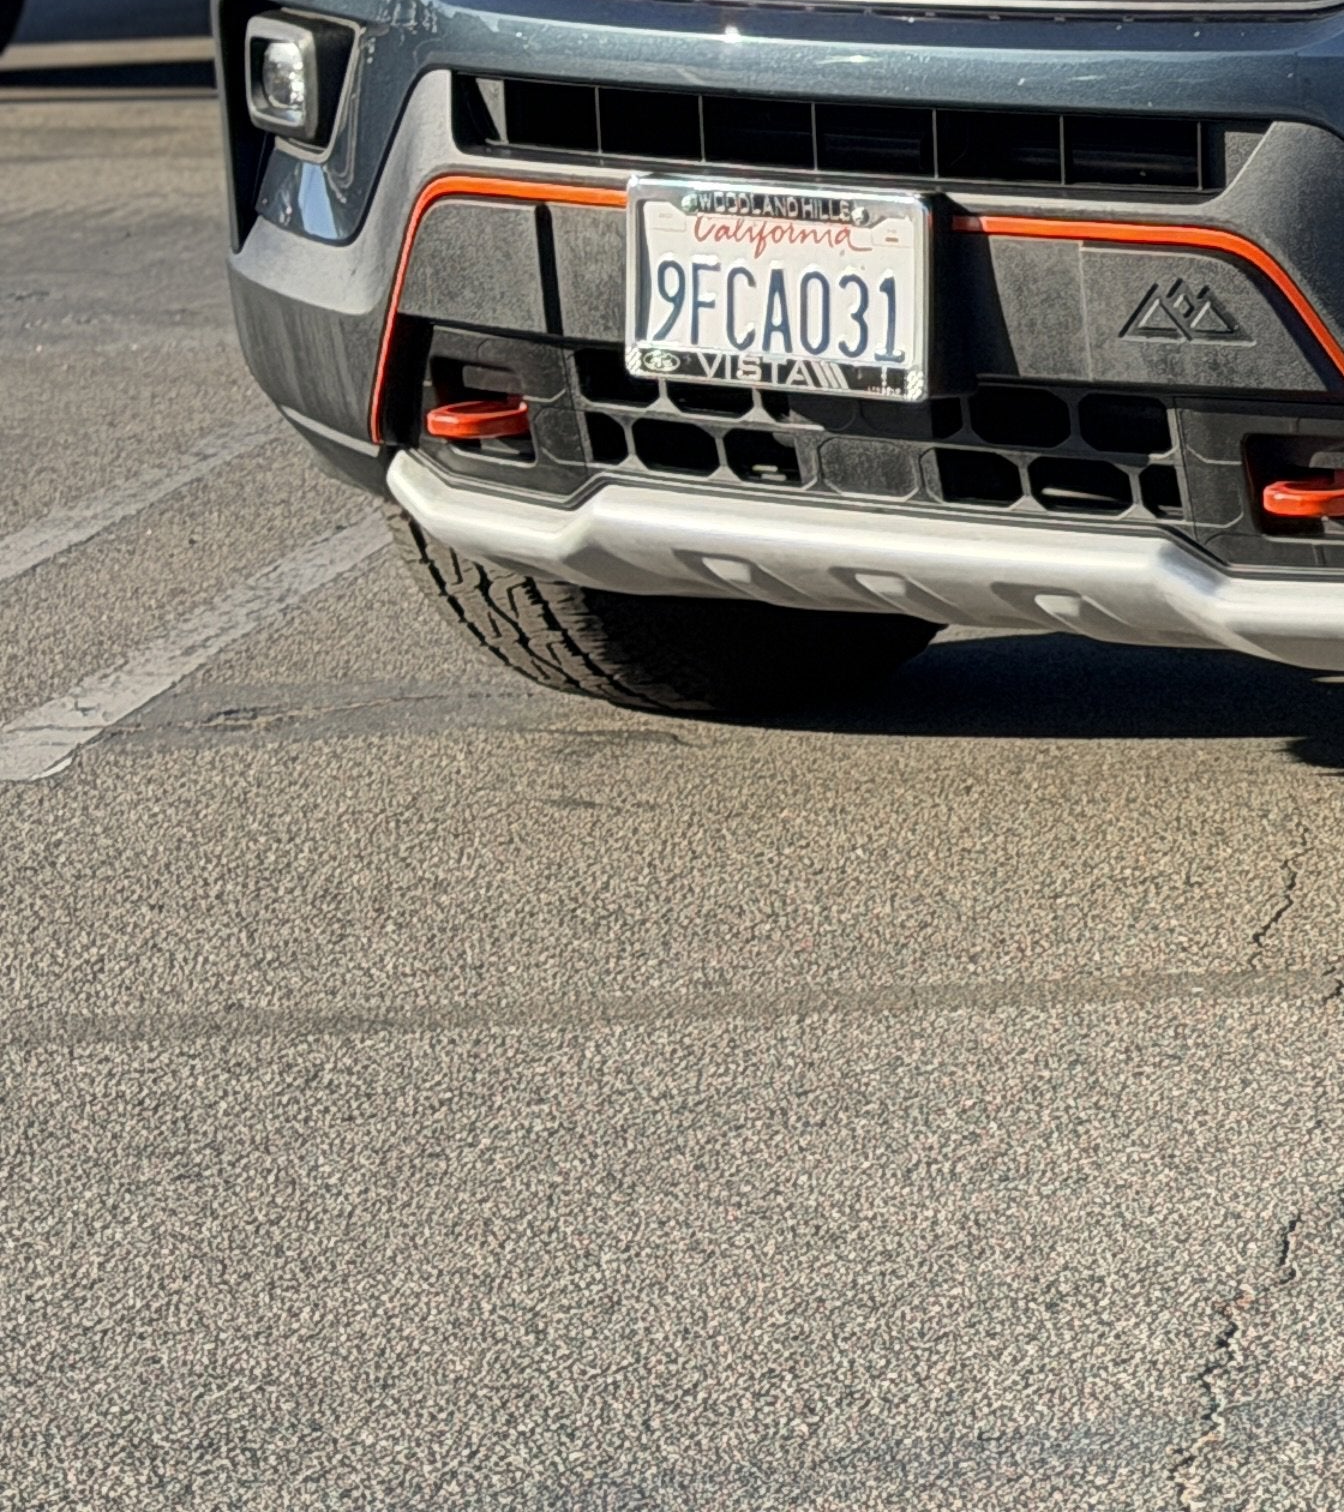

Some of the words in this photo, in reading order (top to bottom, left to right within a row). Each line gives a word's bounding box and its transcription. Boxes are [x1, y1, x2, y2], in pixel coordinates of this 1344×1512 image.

[698, 191, 799, 218] WOODLAND
[694, 213, 873, 259] California
[652, 254, 906, 363] 9FCA031
[697, 352, 823, 388] VISTA
